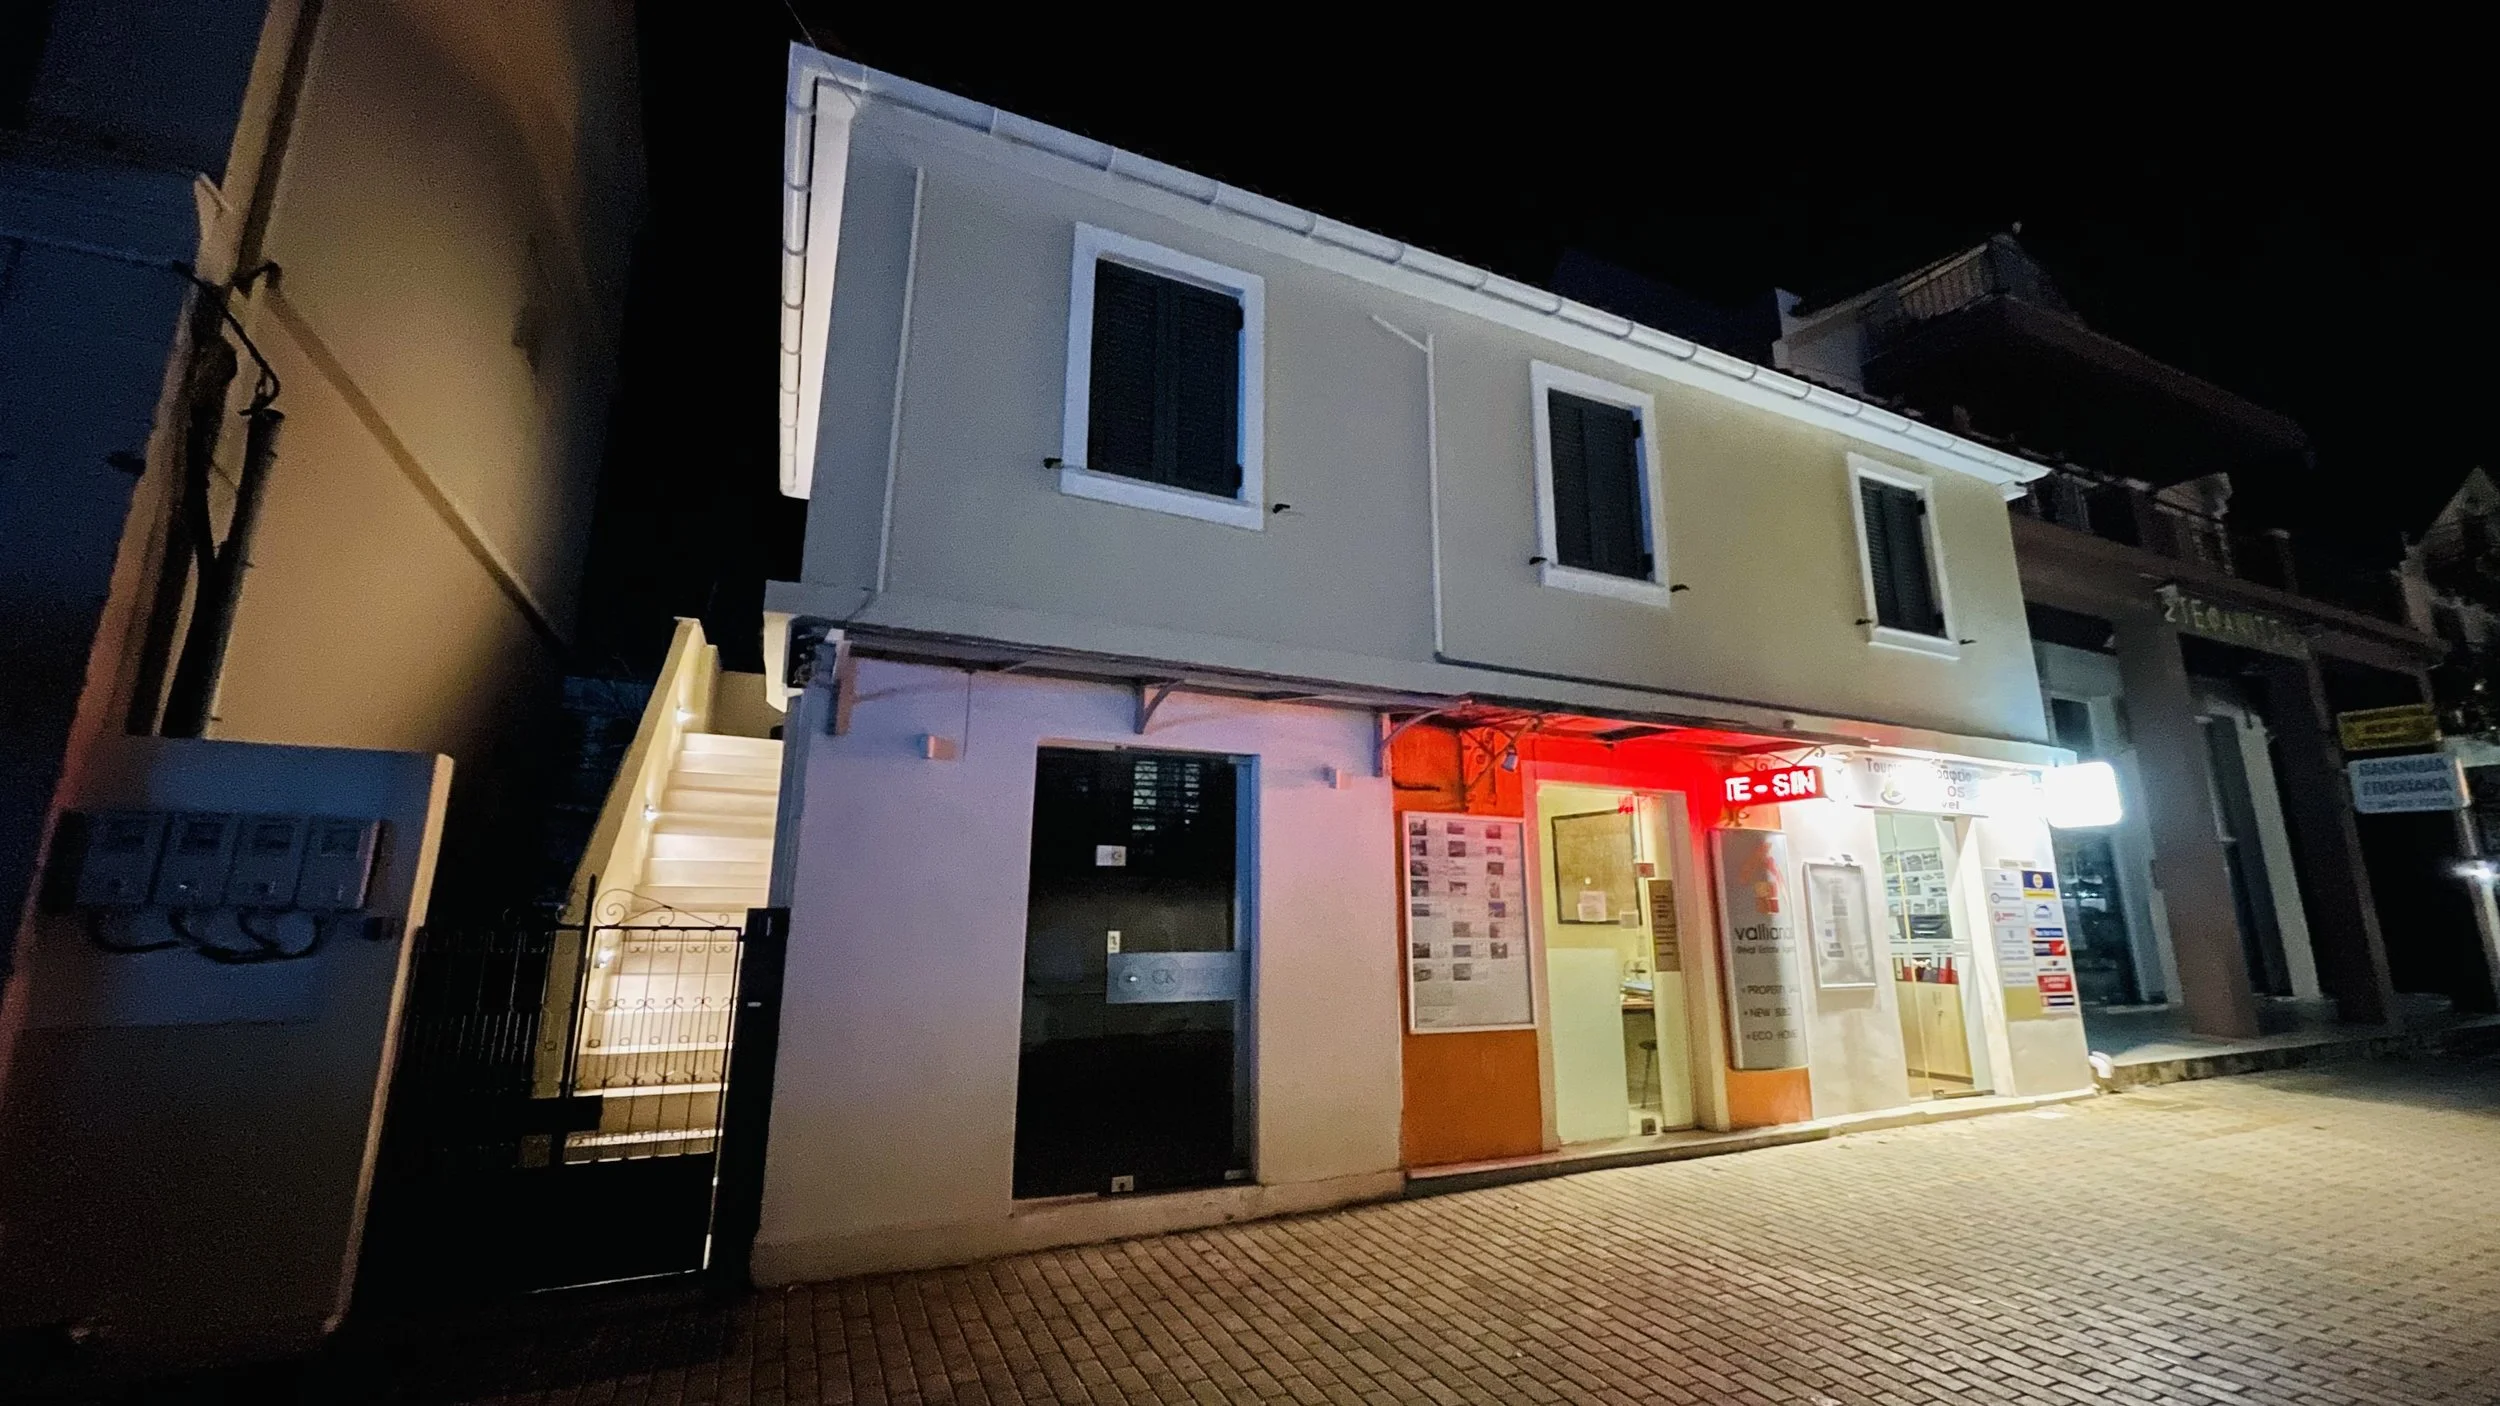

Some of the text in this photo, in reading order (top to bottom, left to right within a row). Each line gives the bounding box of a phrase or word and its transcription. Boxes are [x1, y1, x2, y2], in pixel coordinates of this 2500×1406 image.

[1947, 785, 1966, 799] OS
[1941, 801, 1960, 810] vel
[1752, 1031, 1773, 1041] ECO
